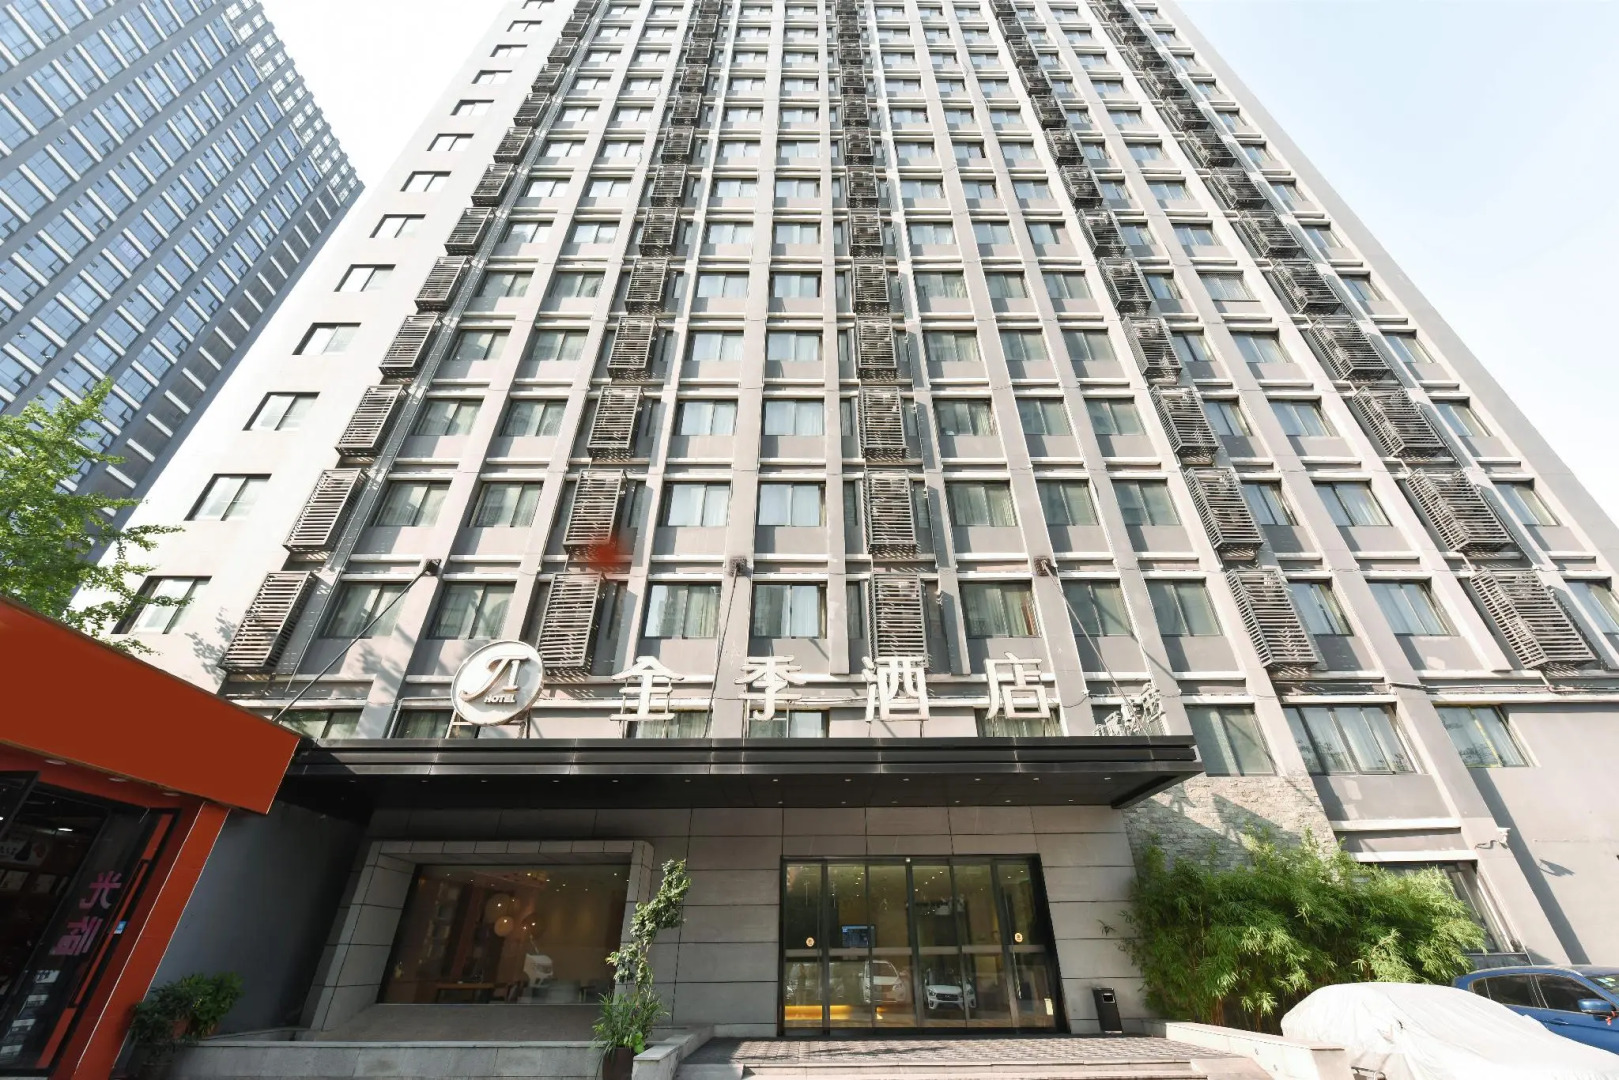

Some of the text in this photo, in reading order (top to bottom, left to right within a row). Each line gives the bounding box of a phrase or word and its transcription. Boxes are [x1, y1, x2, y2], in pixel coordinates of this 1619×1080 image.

[484, 694, 517, 704] HOTEL
[609, 652, 1050, 721] 全季酒店
